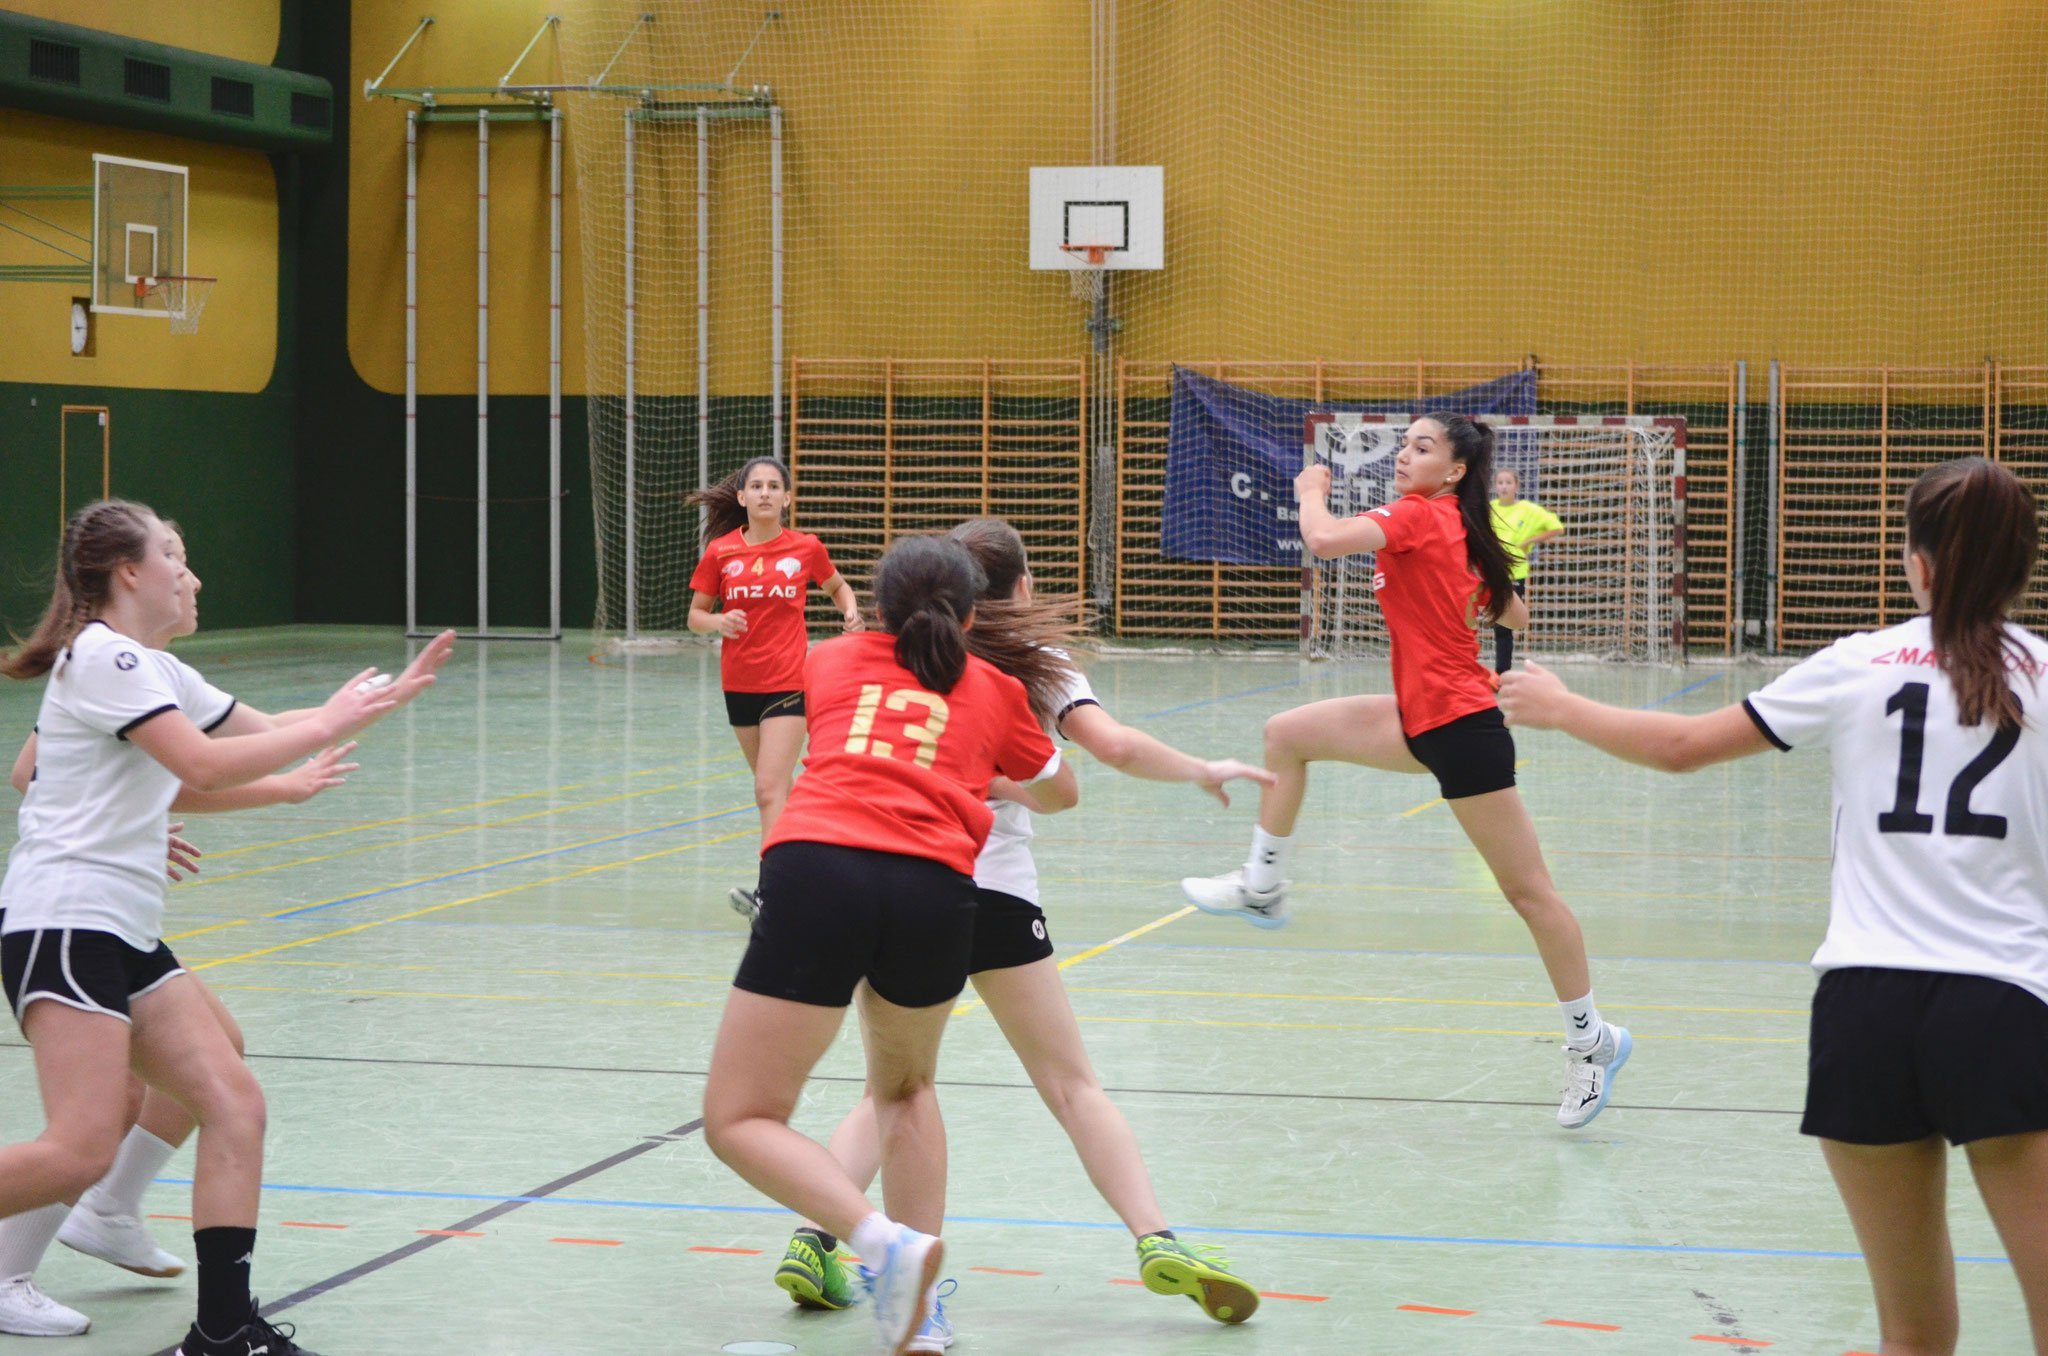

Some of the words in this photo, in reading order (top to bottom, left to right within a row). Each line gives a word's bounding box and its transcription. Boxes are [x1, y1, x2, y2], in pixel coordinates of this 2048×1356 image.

[1277, 539, 1304, 550] ww
[751, 557, 764, 576] 4
[768, 584, 797, 598] AG
[844, 684, 949, 770] 13
[1878, 682, 2023, 840] 12
